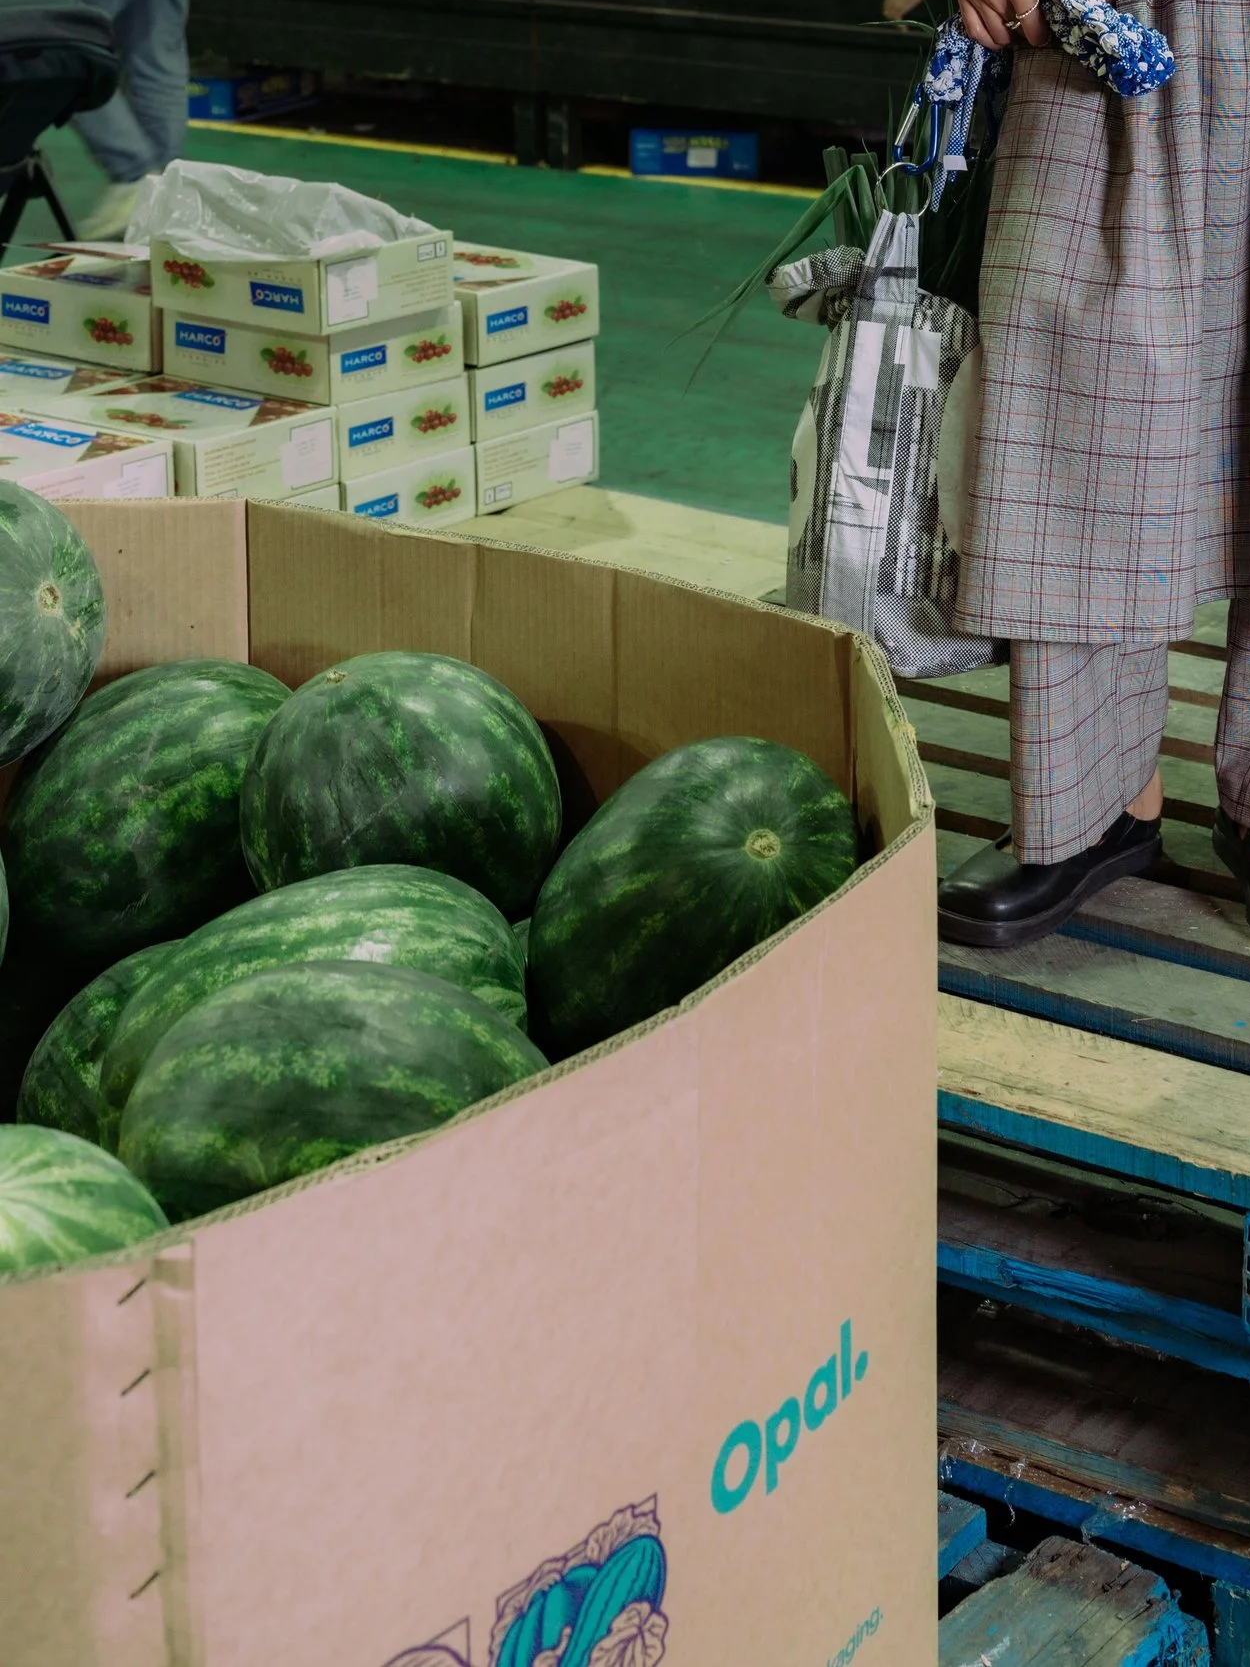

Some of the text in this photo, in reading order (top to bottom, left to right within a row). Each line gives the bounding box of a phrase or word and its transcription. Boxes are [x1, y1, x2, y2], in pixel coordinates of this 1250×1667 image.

[256, 288, 299, 306] HARCO
[5, 300, 46, 317] HARCO
[490, 312, 525, 329] HARCO
[179, 330, 222, 347] HARCO
[344, 352, 383, 368] HARCO
[489, 389, 523, 405] HARCO
[352, 422, 390, 441] HARCO
[711, 1317, 868, 1515] Opal.
